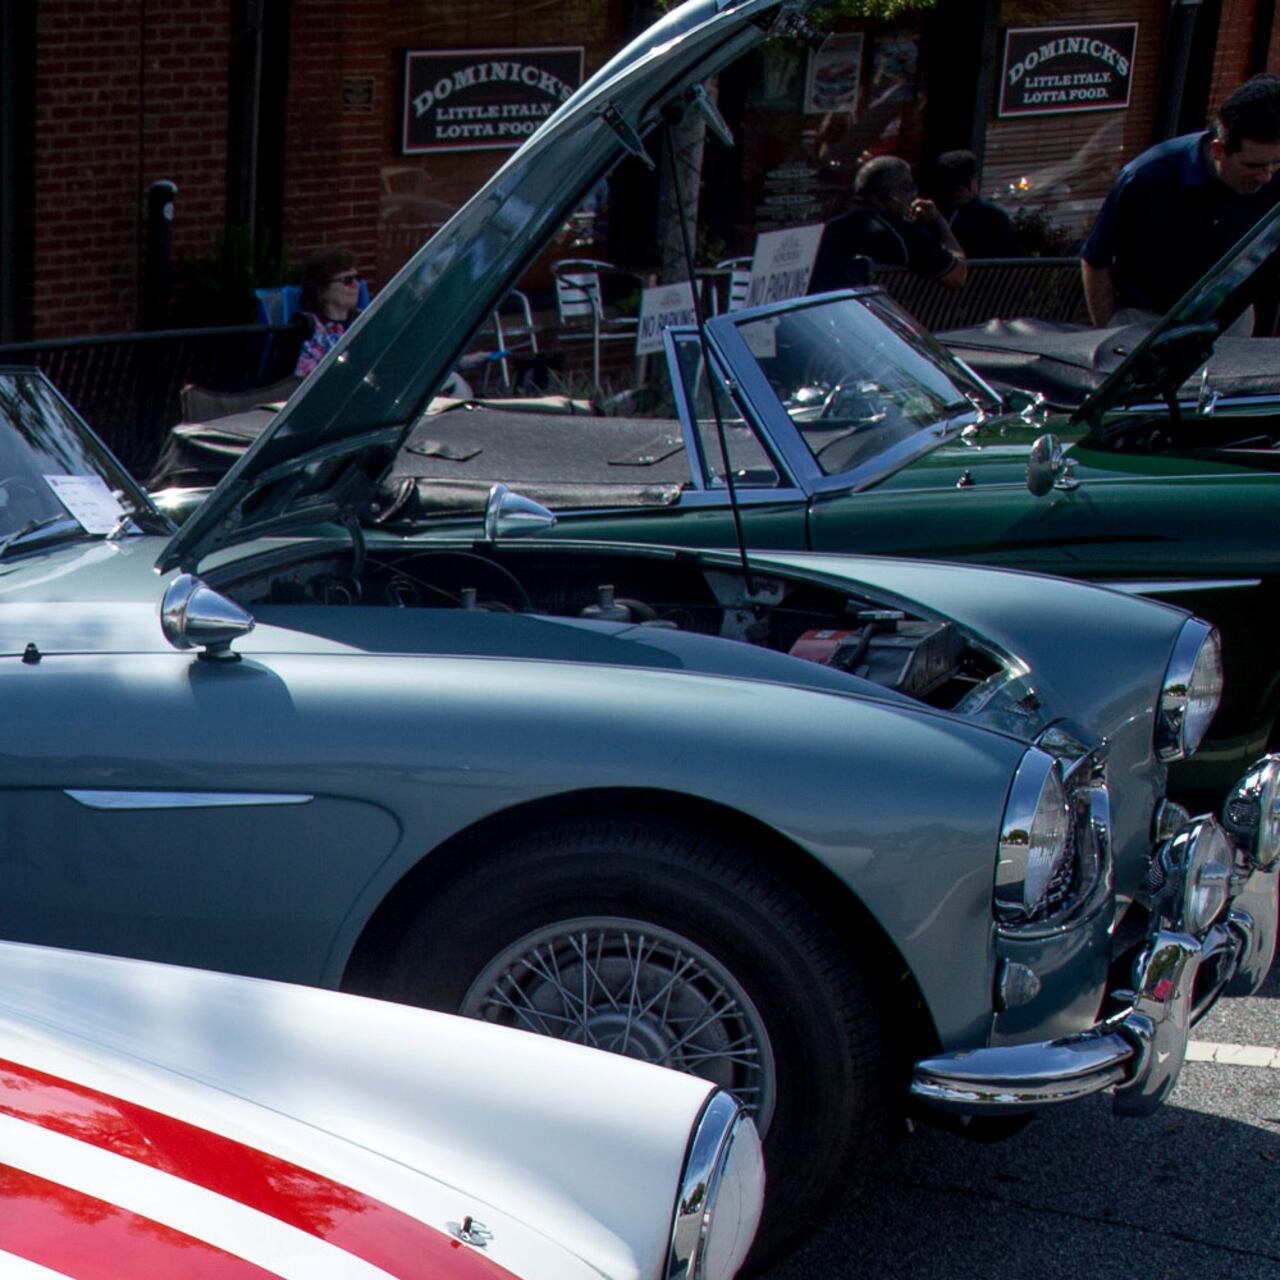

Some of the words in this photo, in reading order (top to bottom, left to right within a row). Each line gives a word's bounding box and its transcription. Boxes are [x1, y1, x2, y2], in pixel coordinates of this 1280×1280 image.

[1008, 37, 1129, 86] DOMINICK'S
[1024, 74, 1072, 88] LITTLE
[1073, 71, 1112, 86] ITALY.
[413, 61, 575, 118] DOMINICK'S
[1023, 91, 1067, 104] LOTTA
[1069, 87, 1109, 101] FOOD.
[436, 105, 500, 122] LITTLE
[435, 123, 494, 139] LOTTA
[498, 121, 541, 136] FOO
[642, 316, 656, 338] NO
